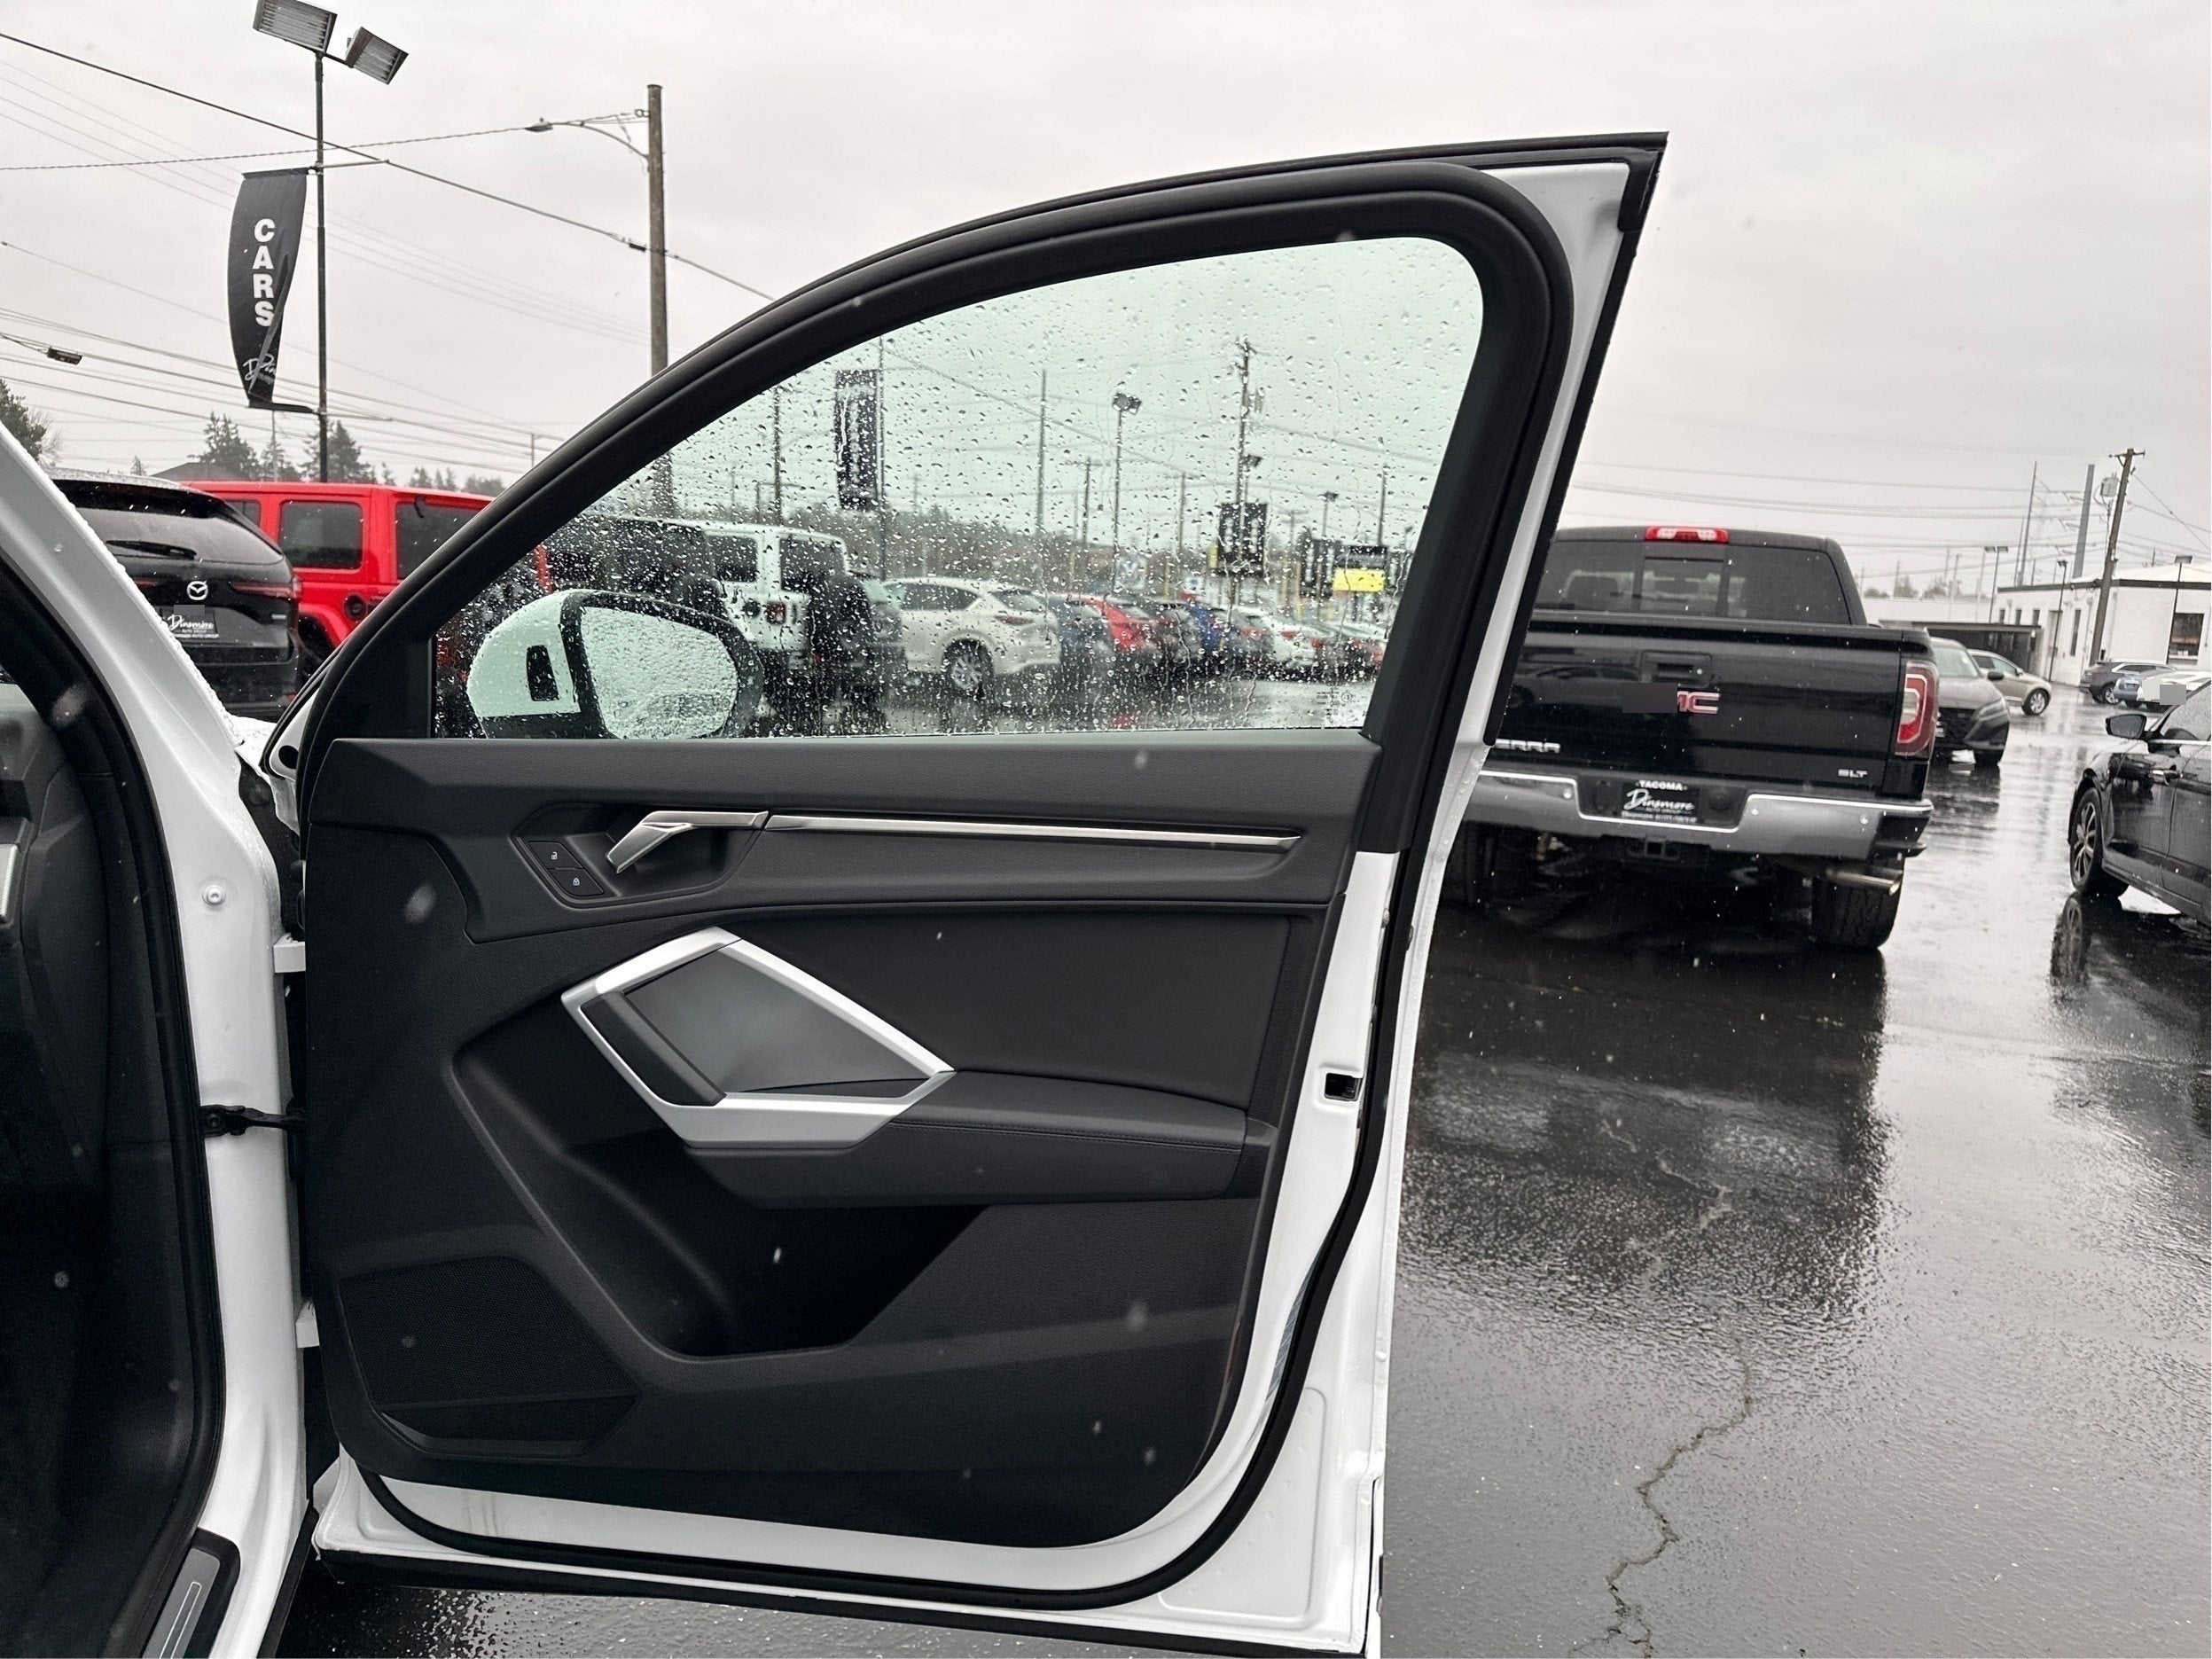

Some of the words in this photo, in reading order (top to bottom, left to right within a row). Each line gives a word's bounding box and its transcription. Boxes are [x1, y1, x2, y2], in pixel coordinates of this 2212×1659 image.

[252, 218, 276, 327] CARS
[1495, 738, 1561, 755] ERRA
[1638, 779, 1684, 791] TACOMA
